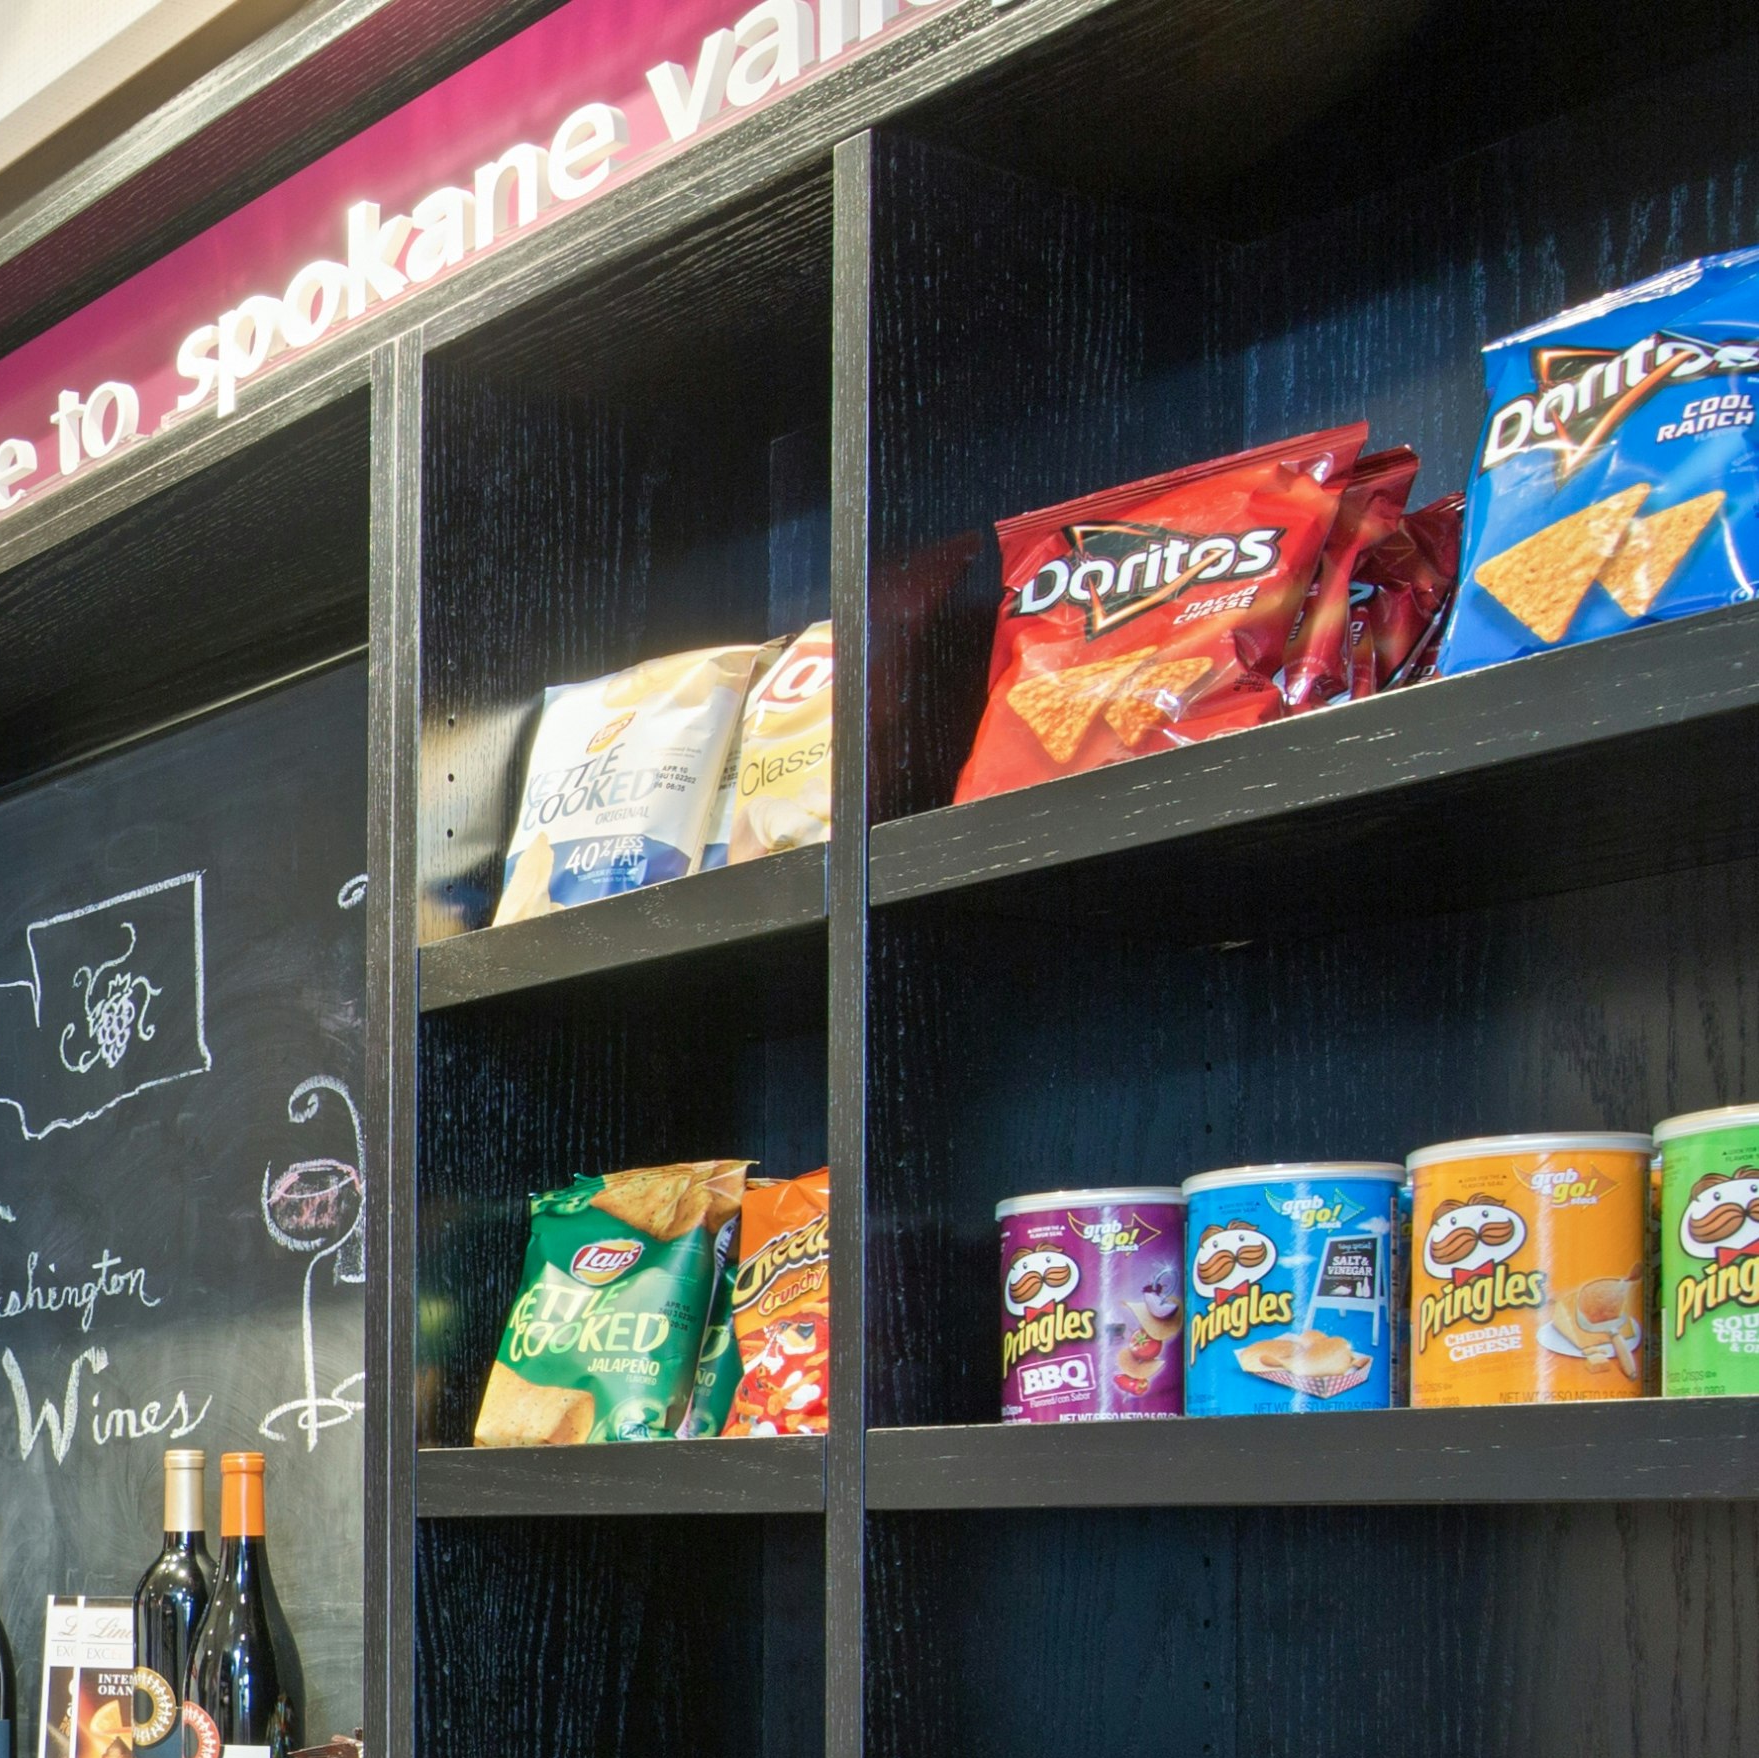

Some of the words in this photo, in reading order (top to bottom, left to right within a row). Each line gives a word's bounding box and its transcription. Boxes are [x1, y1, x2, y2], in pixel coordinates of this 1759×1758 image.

[51, 380, 138, 475] to
[177, 100, 630, 417] spokane
[1482, 335, 1759, 468] Doritos
[1682, 394, 1754, 419] COOL
[1656, 410, 1755, 444] RANCH
[1019, 528, 1284, 615] Doritos
[1173, 594, 1254, 625] CHEESE
[1184, 585, 1259, 613] NACHO
[527, 743, 626, 799] KETTLE
[523, 767, 657, 831] COOKED
[595, 805, 649, 826] ORIGINAL
[565, 839, 614, 875] 40%
[614, 836, 644, 849] LESS
[611, 849, 644, 866] FAT
[1531, 1168, 1578, 1189] grab
[1553, 1178, 1597, 1207] go!
[1282, 1196, 1324, 1214] grab
[1083, 1220, 1122, 1239] grab
[575, 1242, 645, 1273] Lay's
[1327, 1266, 1373, 1277] VINEGAR
[511, 1281, 628, 1329] KETTLE
[759, 1266, 826, 1315] Crunchy
[1676, 1256, 1759, 1340] Pring
[1191, 1283, 1294, 1366] Pringles
[1419, 1265, 1544, 1354] Pringles
[1713, 1314, 1759, 1333] SOU
[509, 1312, 669, 1363] COOKED
[1003, 1303, 1096, 1379] Pringles
[1444, 1325, 1522, 1346] CHEDDAR
[1449, 1338, 1522, 1361] CHEESE
[588, 1356, 660, 1377] JALAPEÑO
[1021, 1360, 1089, 1395] BBQ
[1, 1346, 212, 1465] Wines
